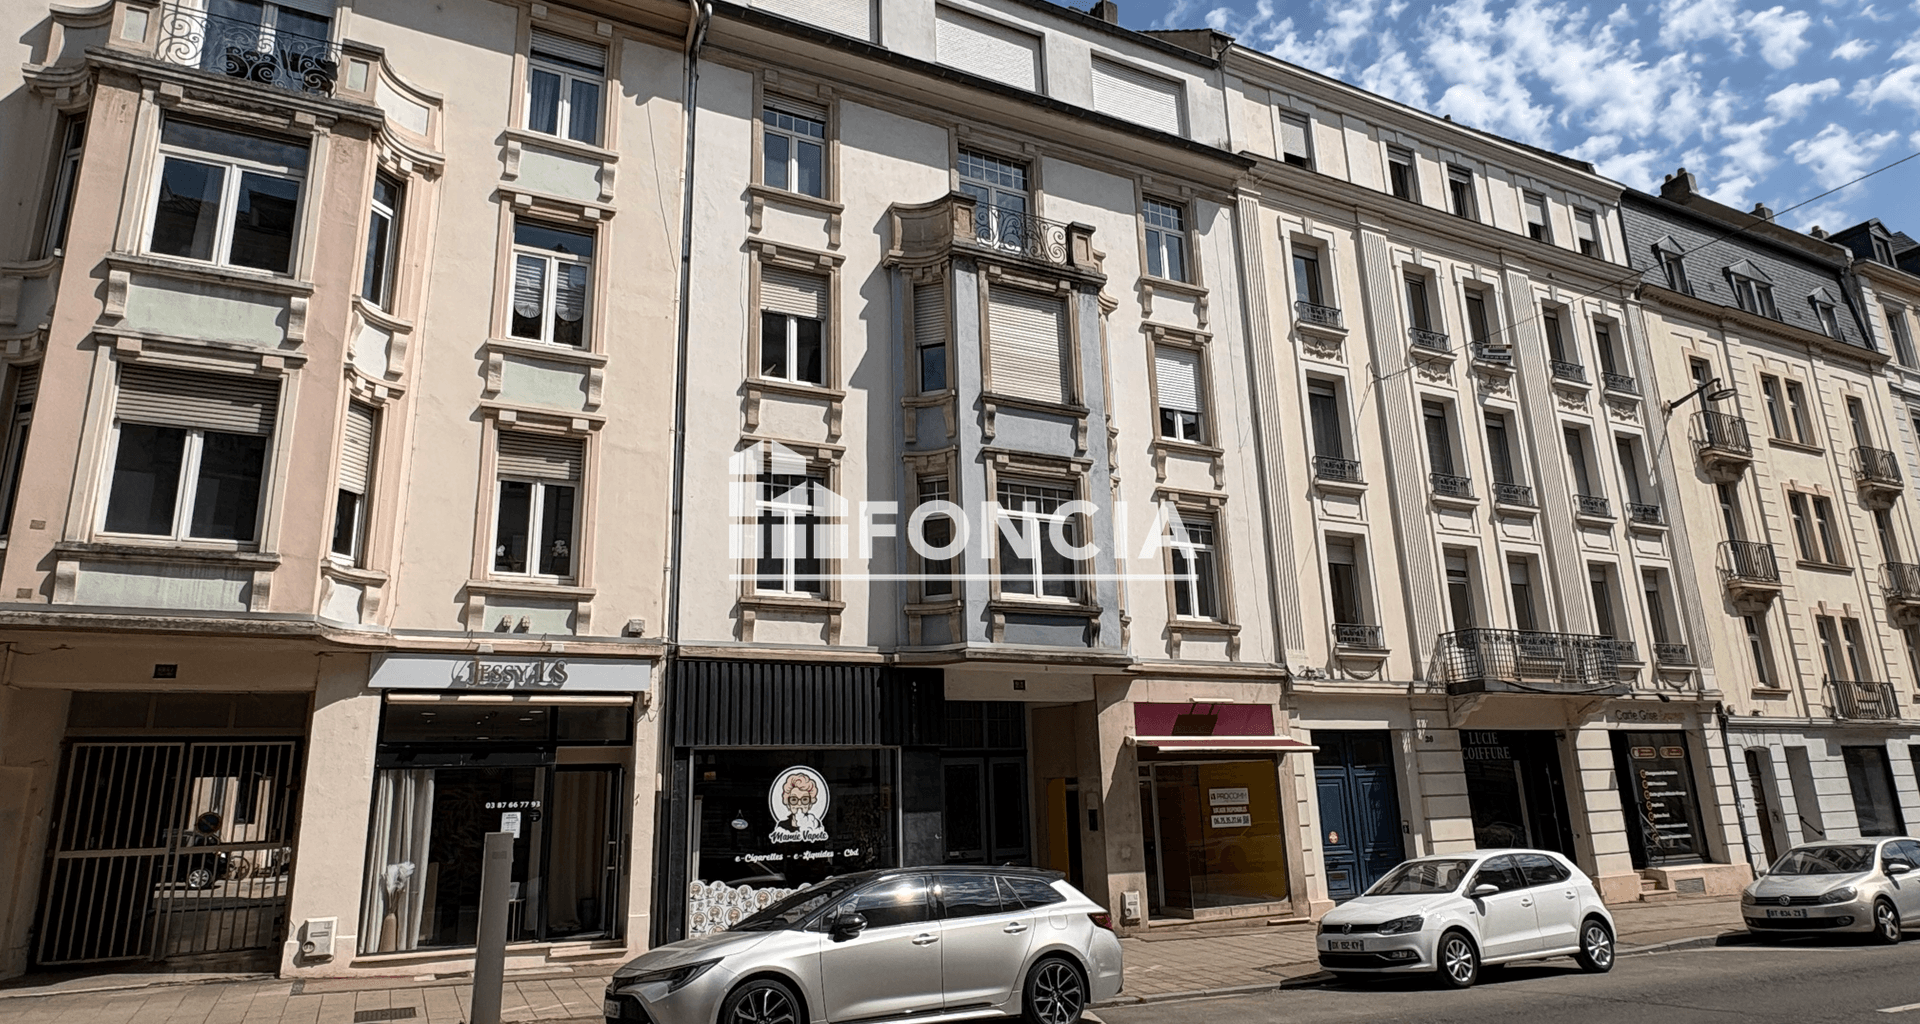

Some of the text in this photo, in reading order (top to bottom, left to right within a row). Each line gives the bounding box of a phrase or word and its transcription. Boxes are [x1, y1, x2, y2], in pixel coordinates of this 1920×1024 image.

[1615, 709, 1638, 721] Carte
[1468, 731, 1498, 745] LUCIE
[1461, 746, 1512, 760] COIFFURE
[508, 801, 519, 809] 66
[735, 853, 783, 863] e-Cigarettes
[793, 850, 834, 861] e-Liquides
[844, 848, 859, 857] Cbd
